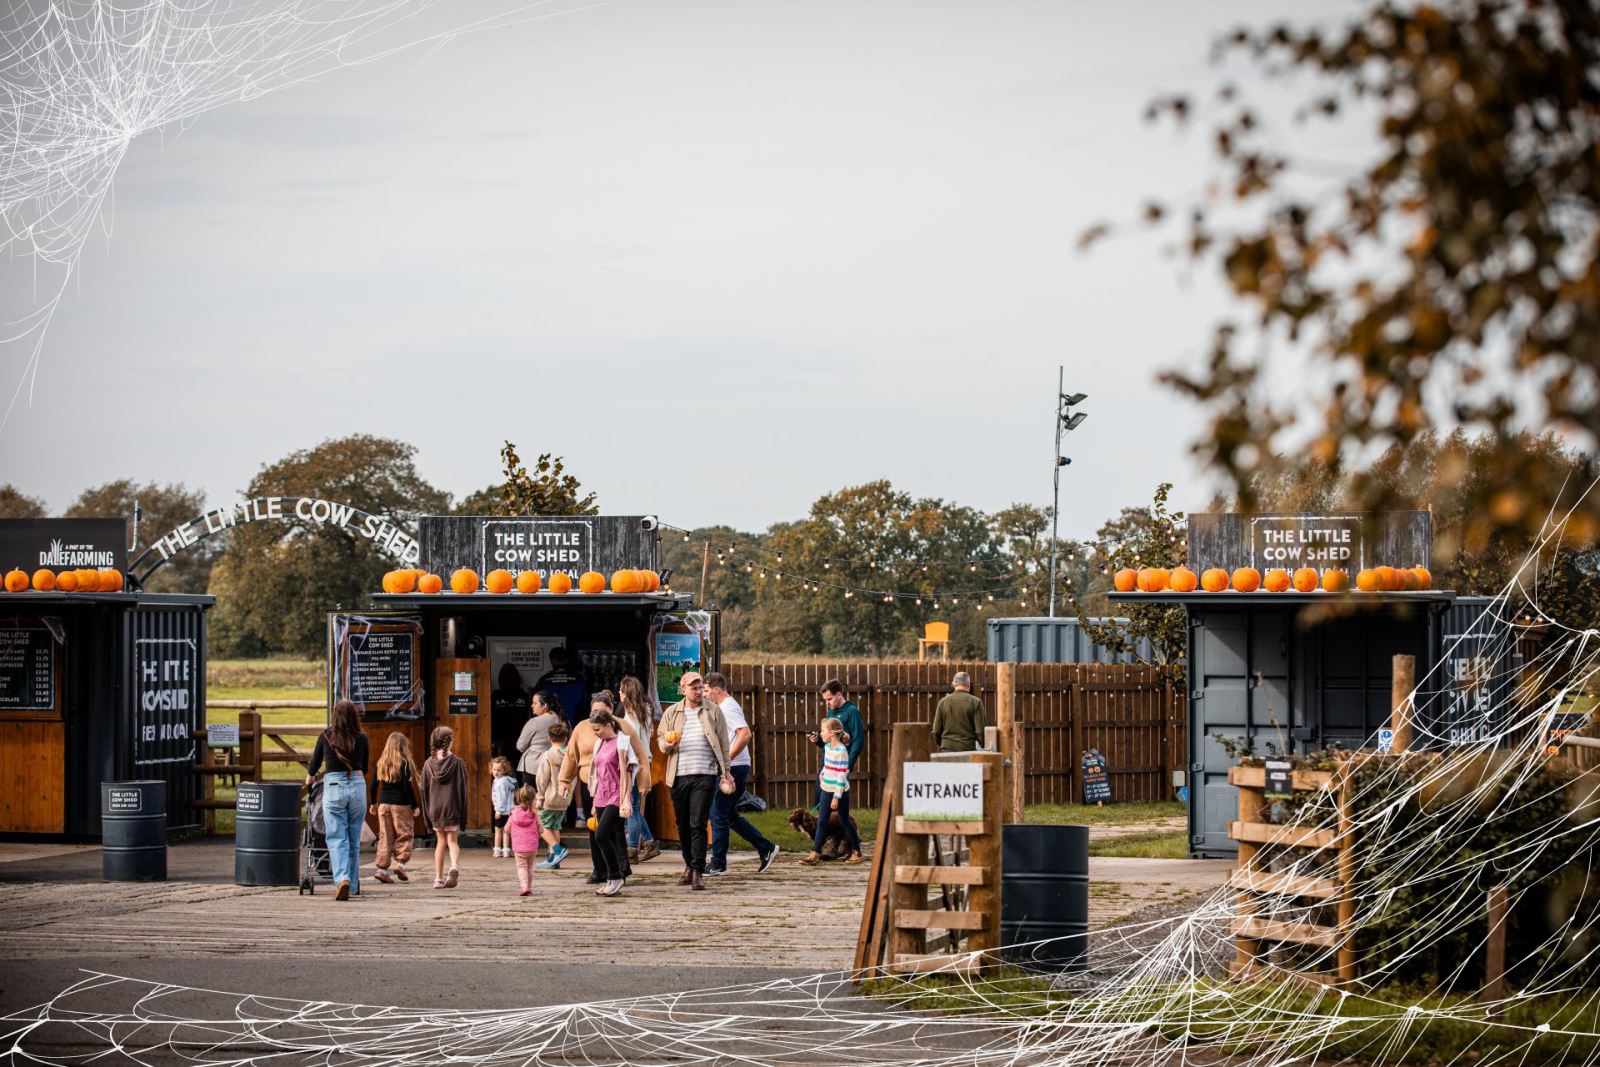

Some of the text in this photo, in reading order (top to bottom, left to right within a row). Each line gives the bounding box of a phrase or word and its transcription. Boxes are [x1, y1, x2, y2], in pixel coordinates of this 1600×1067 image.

[151, 497, 420, 564] THE LITTLE COW SHED
[1263, 529, 1351, 543] THE LITTLE
[494, 533, 580, 546] THE LITTLE
[39, 551, 114, 566] DALEFARMING
[494, 549, 580, 562] COW SHED
[1263, 547, 1351, 560] COW SHED
[906, 783, 980, 799] ENTRANCE
